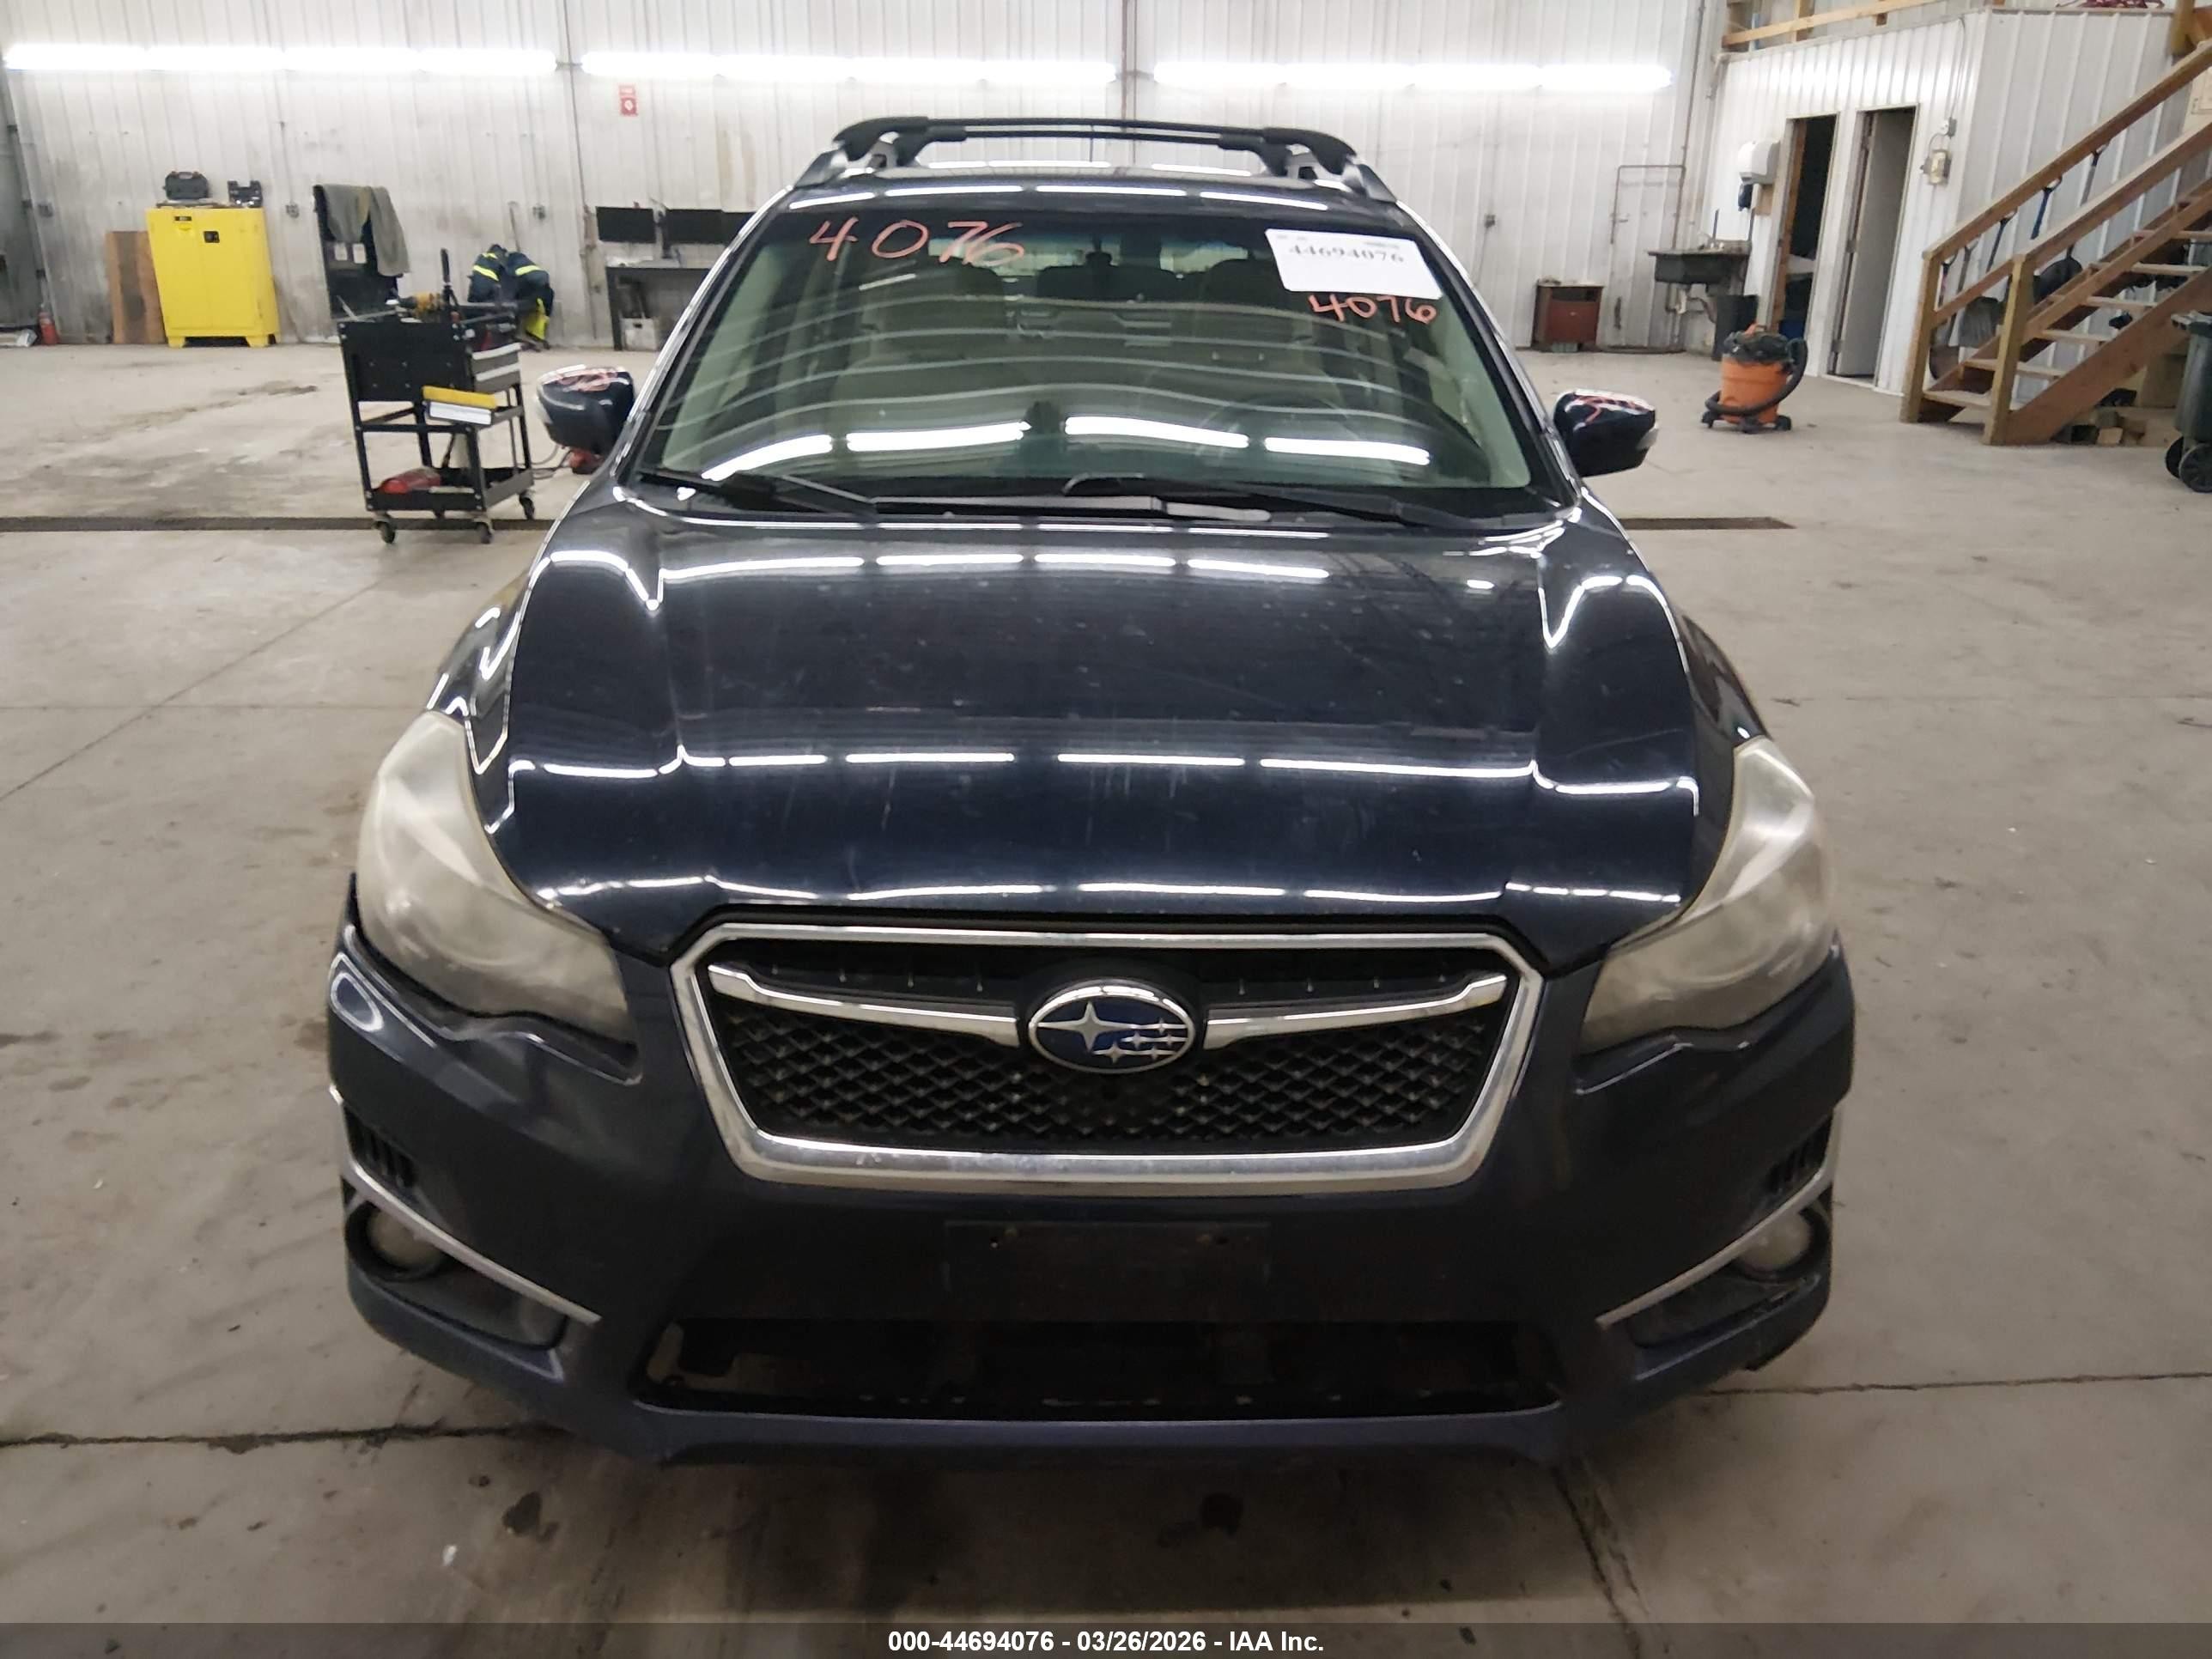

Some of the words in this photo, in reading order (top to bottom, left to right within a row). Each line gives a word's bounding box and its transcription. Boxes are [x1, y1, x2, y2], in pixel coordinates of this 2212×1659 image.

[809, 216, 1024, 266] 4076
[1289, 245, 1405, 263] 44694076
[1308, 294, 1437, 325] 4076
